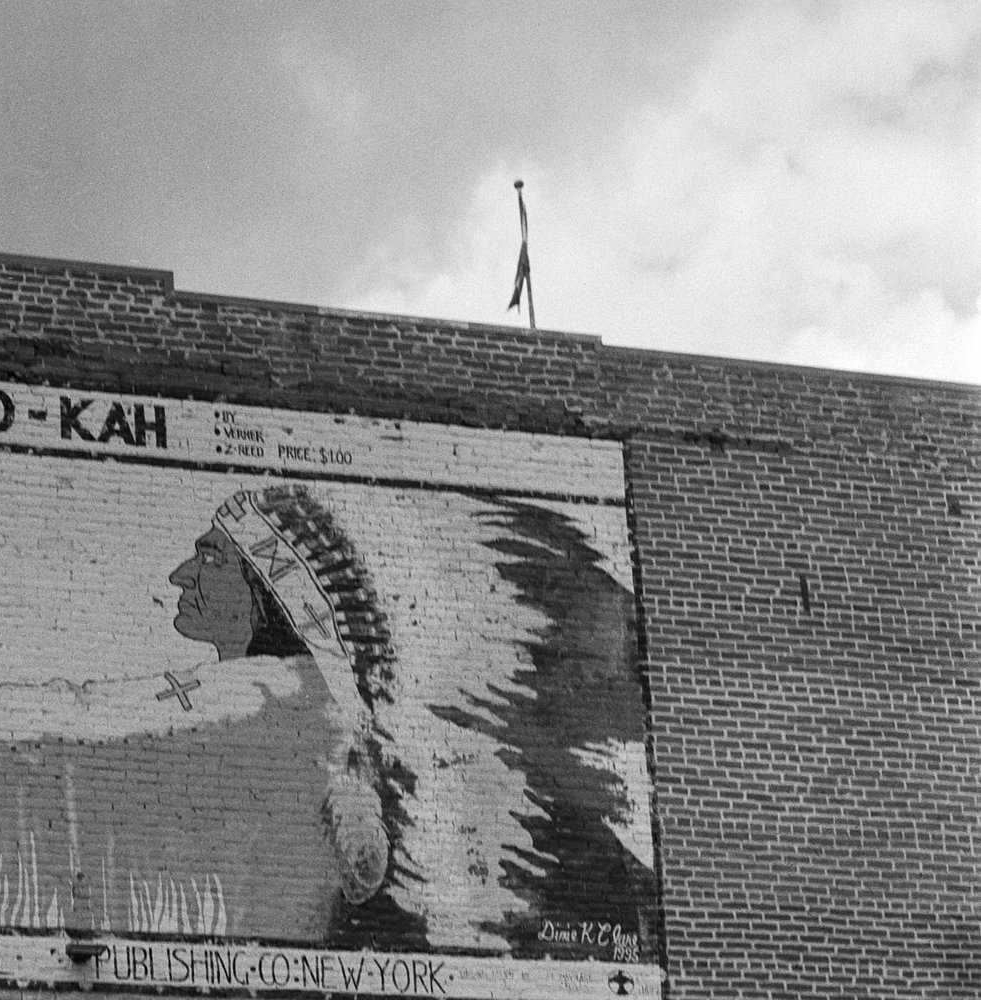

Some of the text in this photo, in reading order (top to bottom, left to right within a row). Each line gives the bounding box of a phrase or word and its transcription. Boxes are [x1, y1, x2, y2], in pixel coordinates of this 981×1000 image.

[59, 396, 168, 449] KAH
[224, 426, 265, 443] VERNER
[613, 945, 640, 963] 1995
